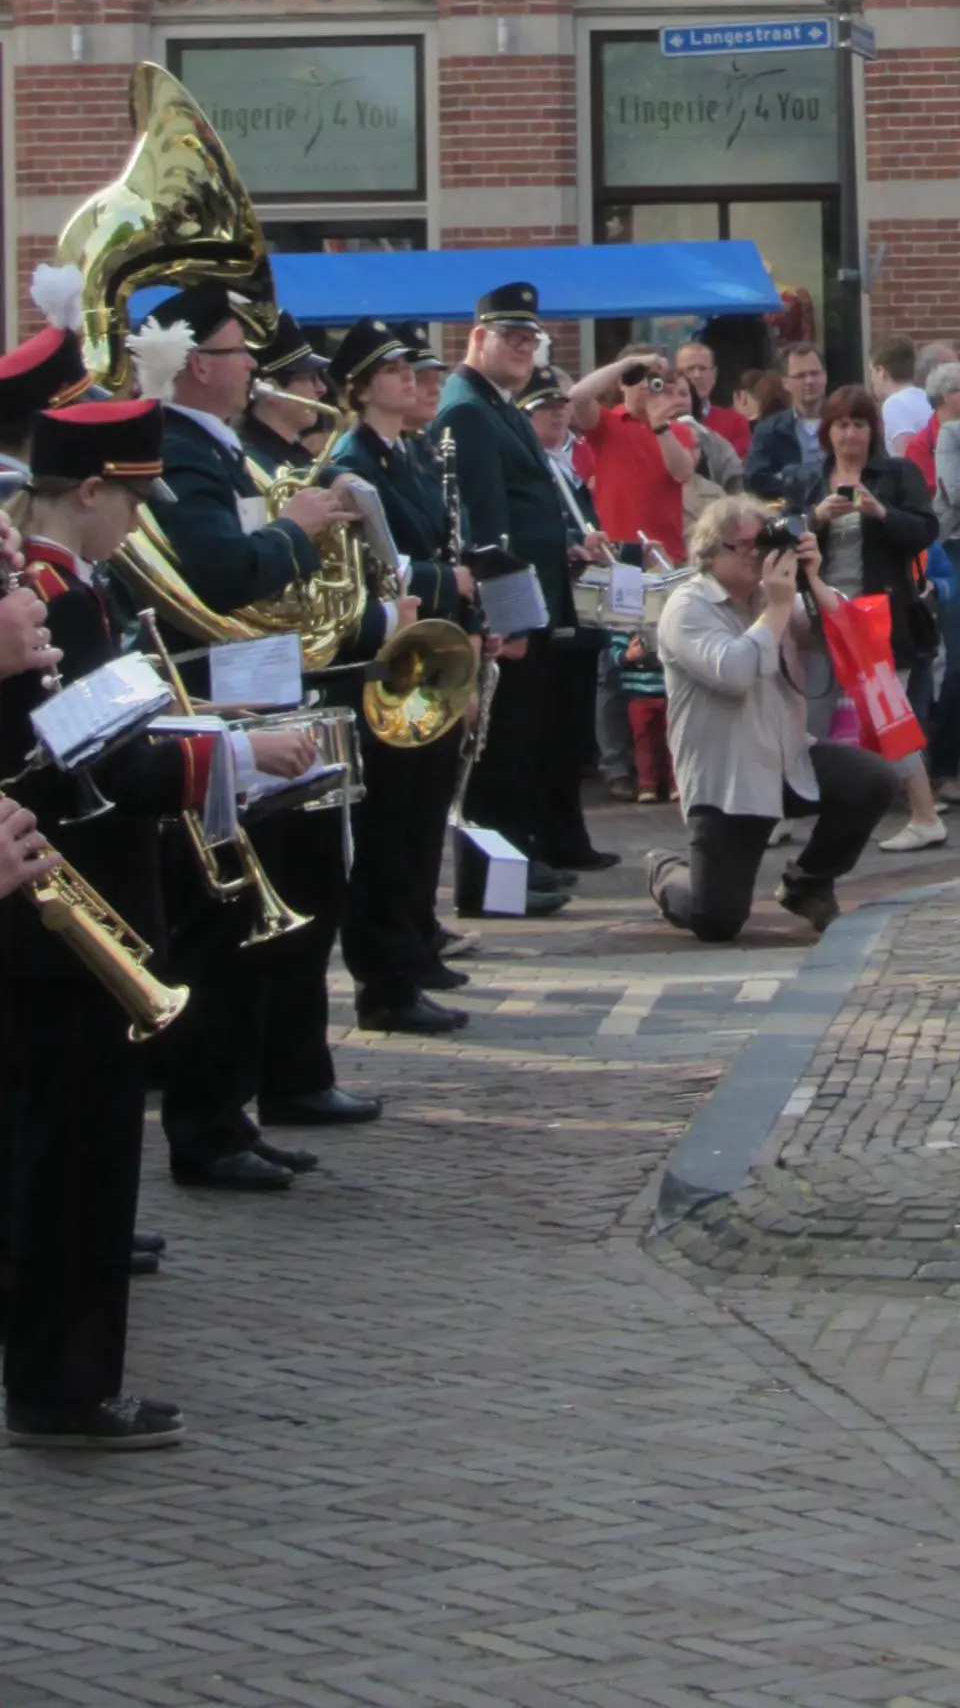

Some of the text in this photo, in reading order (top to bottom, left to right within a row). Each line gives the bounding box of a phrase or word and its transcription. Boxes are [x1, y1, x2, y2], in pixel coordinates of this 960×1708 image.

[690, 25, 801, 47] Langestraat
[333, 100, 348, 130] 4
[356, 100, 398, 130] You
[619, 93, 820, 131] Lingerie 4 You
